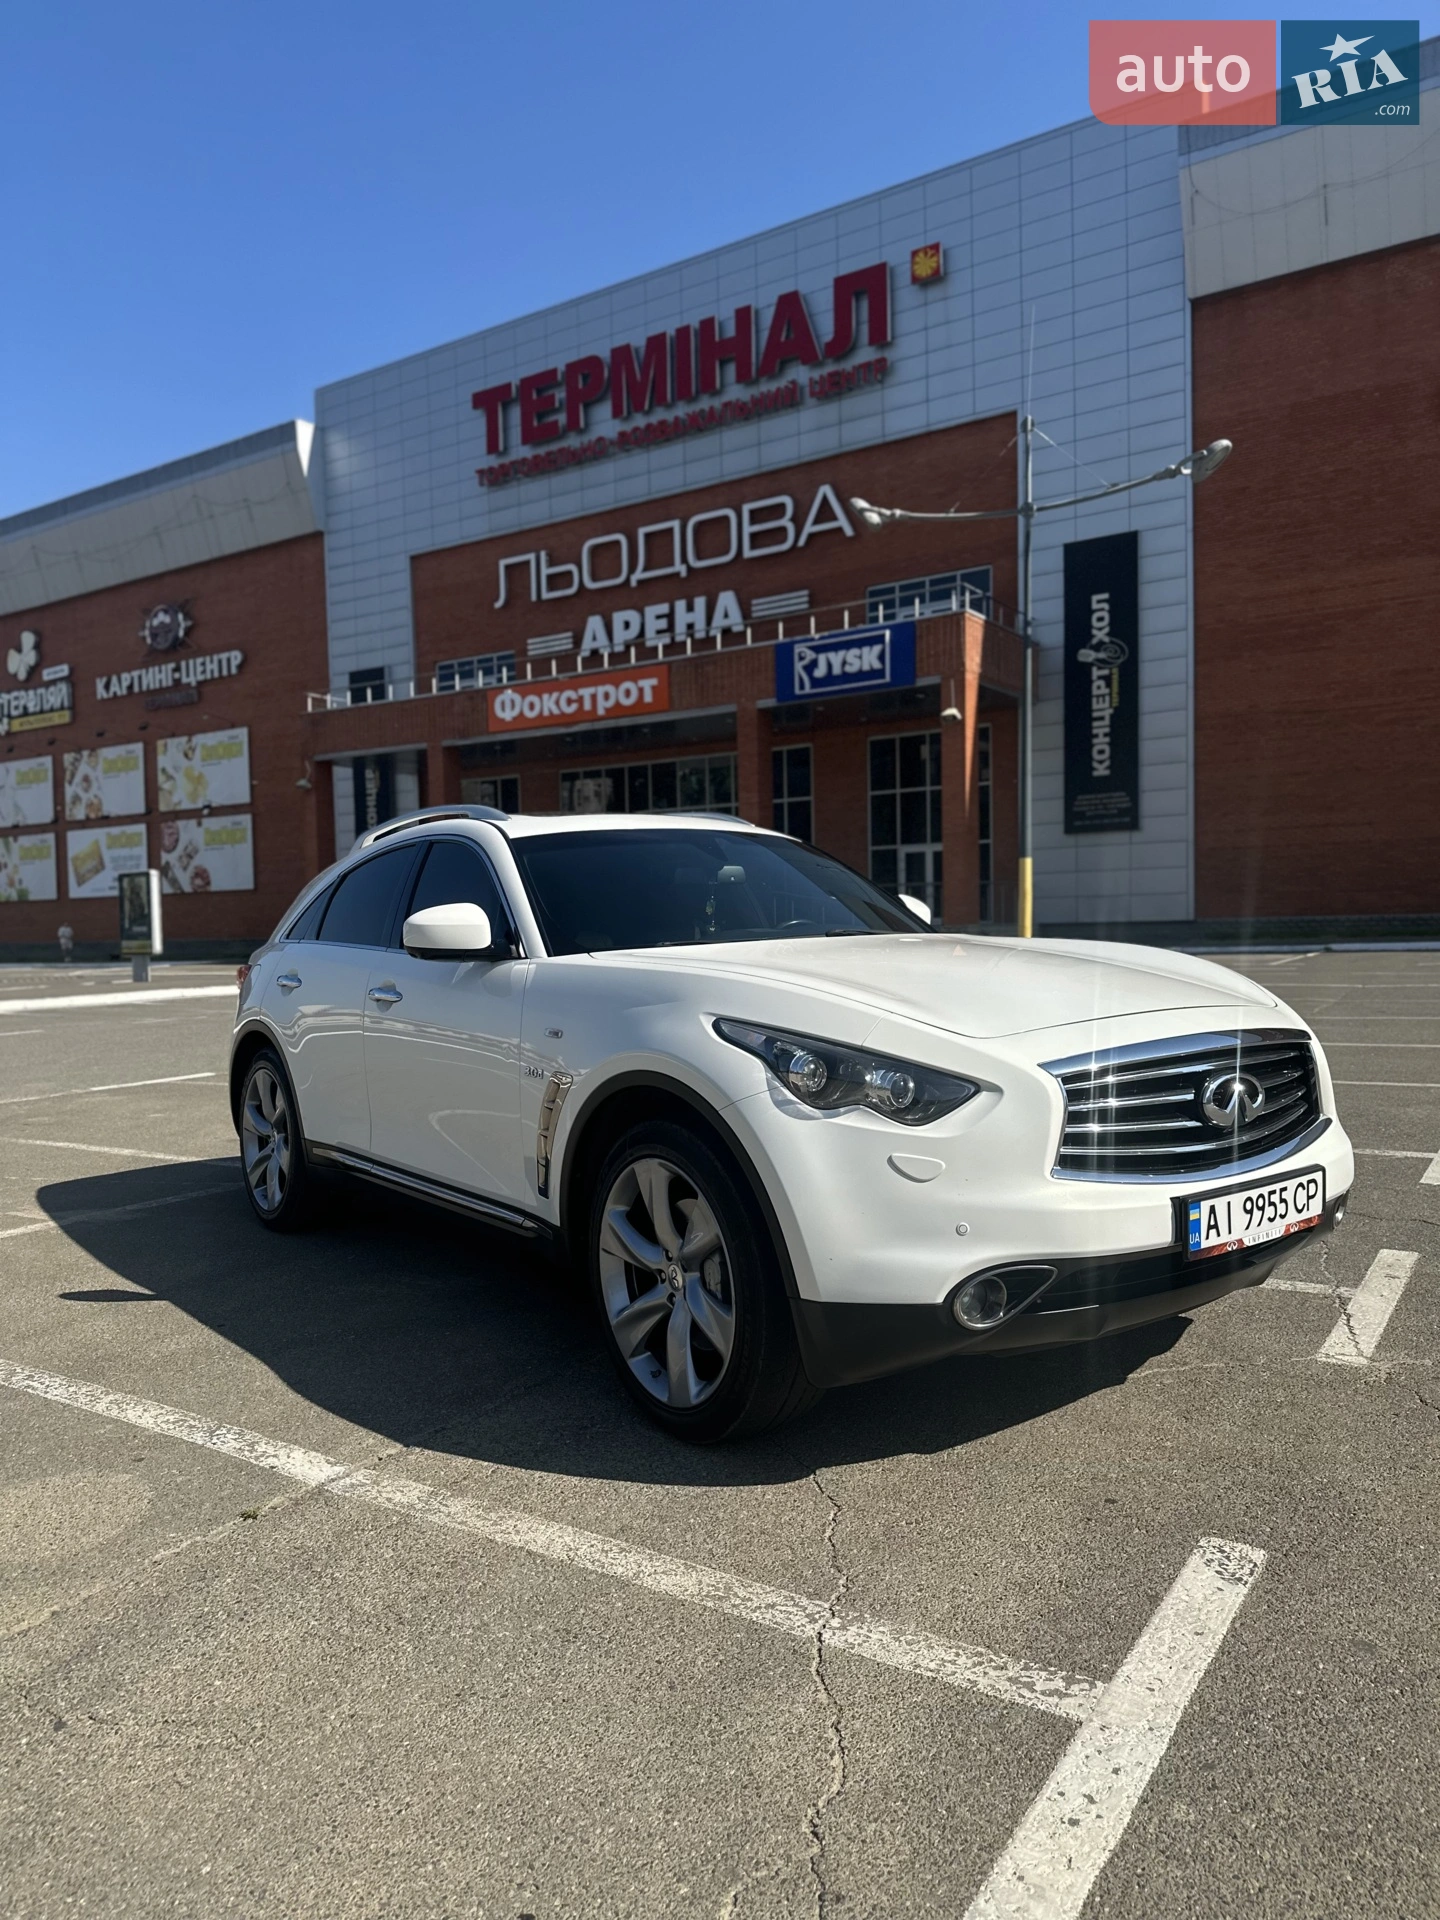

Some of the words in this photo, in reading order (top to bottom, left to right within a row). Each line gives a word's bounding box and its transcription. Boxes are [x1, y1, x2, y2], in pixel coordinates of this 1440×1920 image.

[472, 261, 892, 455] ТЕРМІНАЛ
[809, 356, 888, 399] ЦЕНТР
[494, 484, 855, 608] ЛЬОДОВА
[580, 590, 745, 657] АРЕНА
[1091, 592, 1110, 644] ХОЛ
[96, 650, 243, 700] КАРТИНГ-ЦЕНТР
[813, 644, 884, 678] JYSK
[493, 678, 659, 721] Фокстрот
[1091, 667, 1113, 777] КОНЦЕРТ
[1205, 1200, 1231, 1240] AI
[1243, 1186, 1288, 1231] 9955
[1293, 1178, 1318, 1214] CP
[1190, 1232, 1200, 1244] UA
[1248, 1228, 1281, 1244] INFINITI
